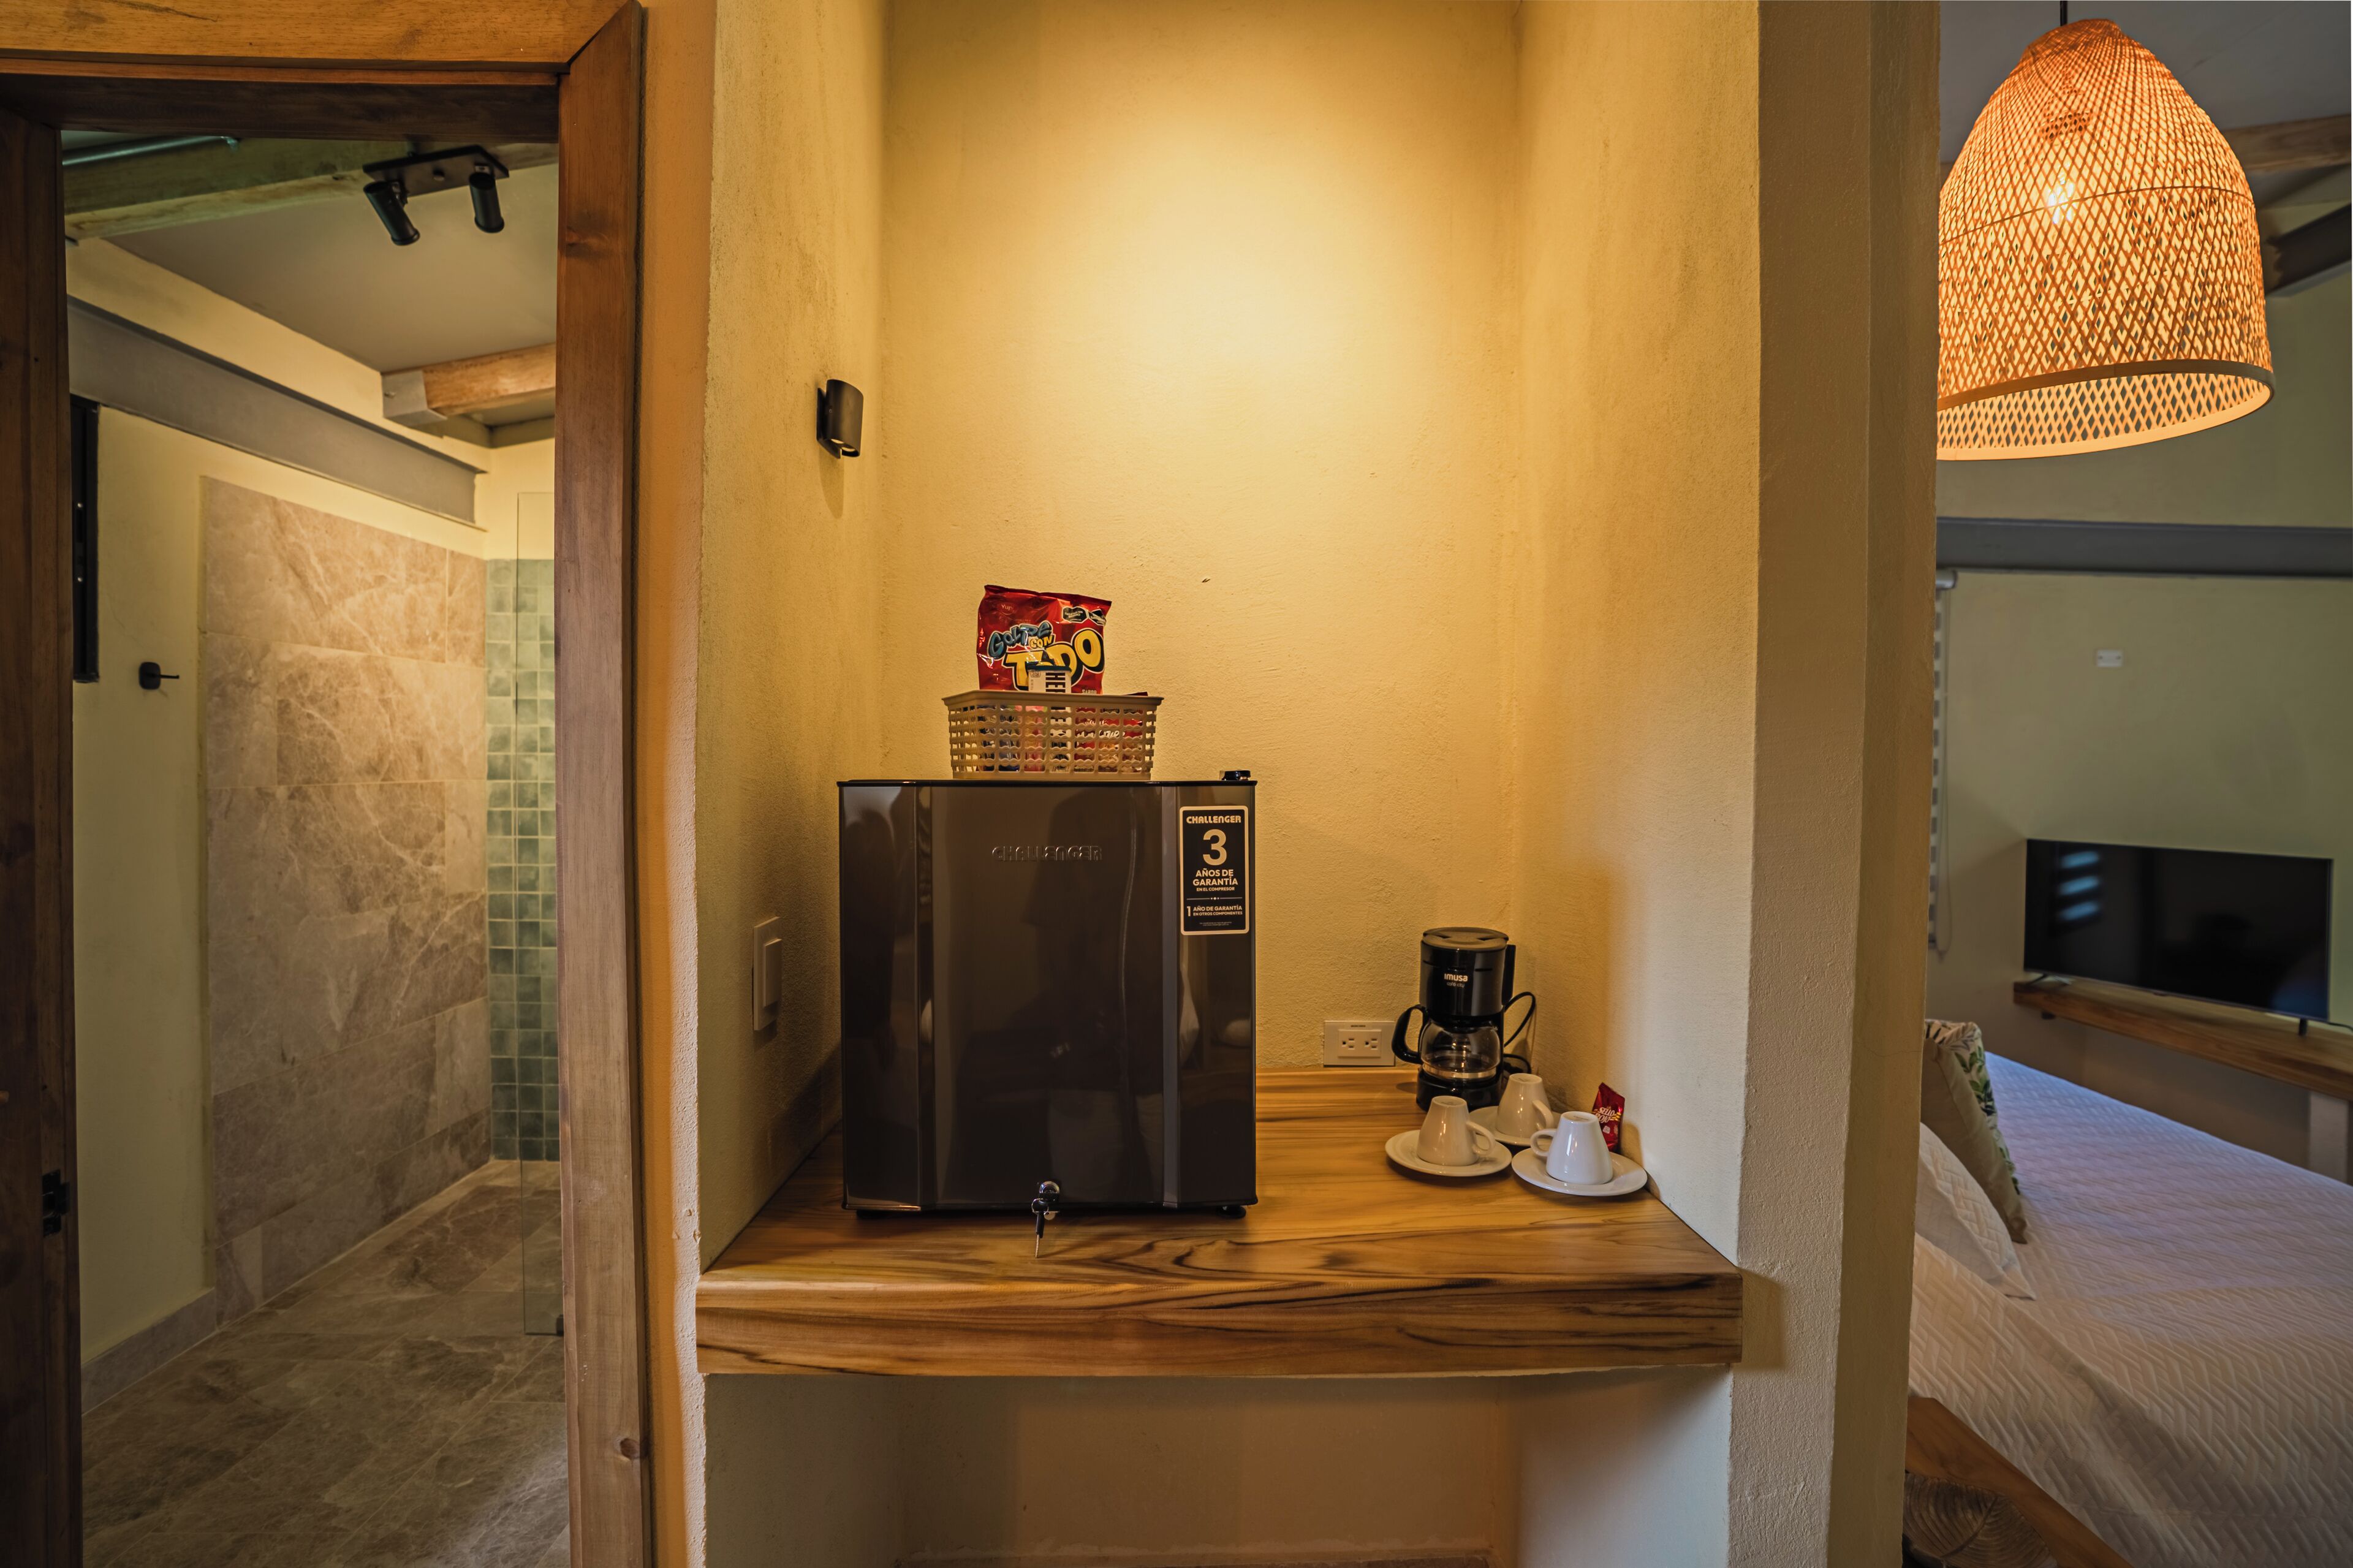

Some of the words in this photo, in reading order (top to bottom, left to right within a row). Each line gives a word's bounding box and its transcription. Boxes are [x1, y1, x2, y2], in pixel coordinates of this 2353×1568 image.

[988, 621, 1053, 659] GOLPE
[1029, 635, 1055, 648] CON
[1005, 629, 1104, 688] TDO
[1186, 815, 1241, 824] CHALLENGER
[1202, 828, 1227, 866] 3
[992, 846, 1103, 861] CHALLENGER
[1195, 868, 1221, 877] AÑOS
[1192, 876, 1238, 886] GARANTÍA
[1186, 906, 1191, 917] 1
[1597, 1107, 1615, 1117] SELLO
